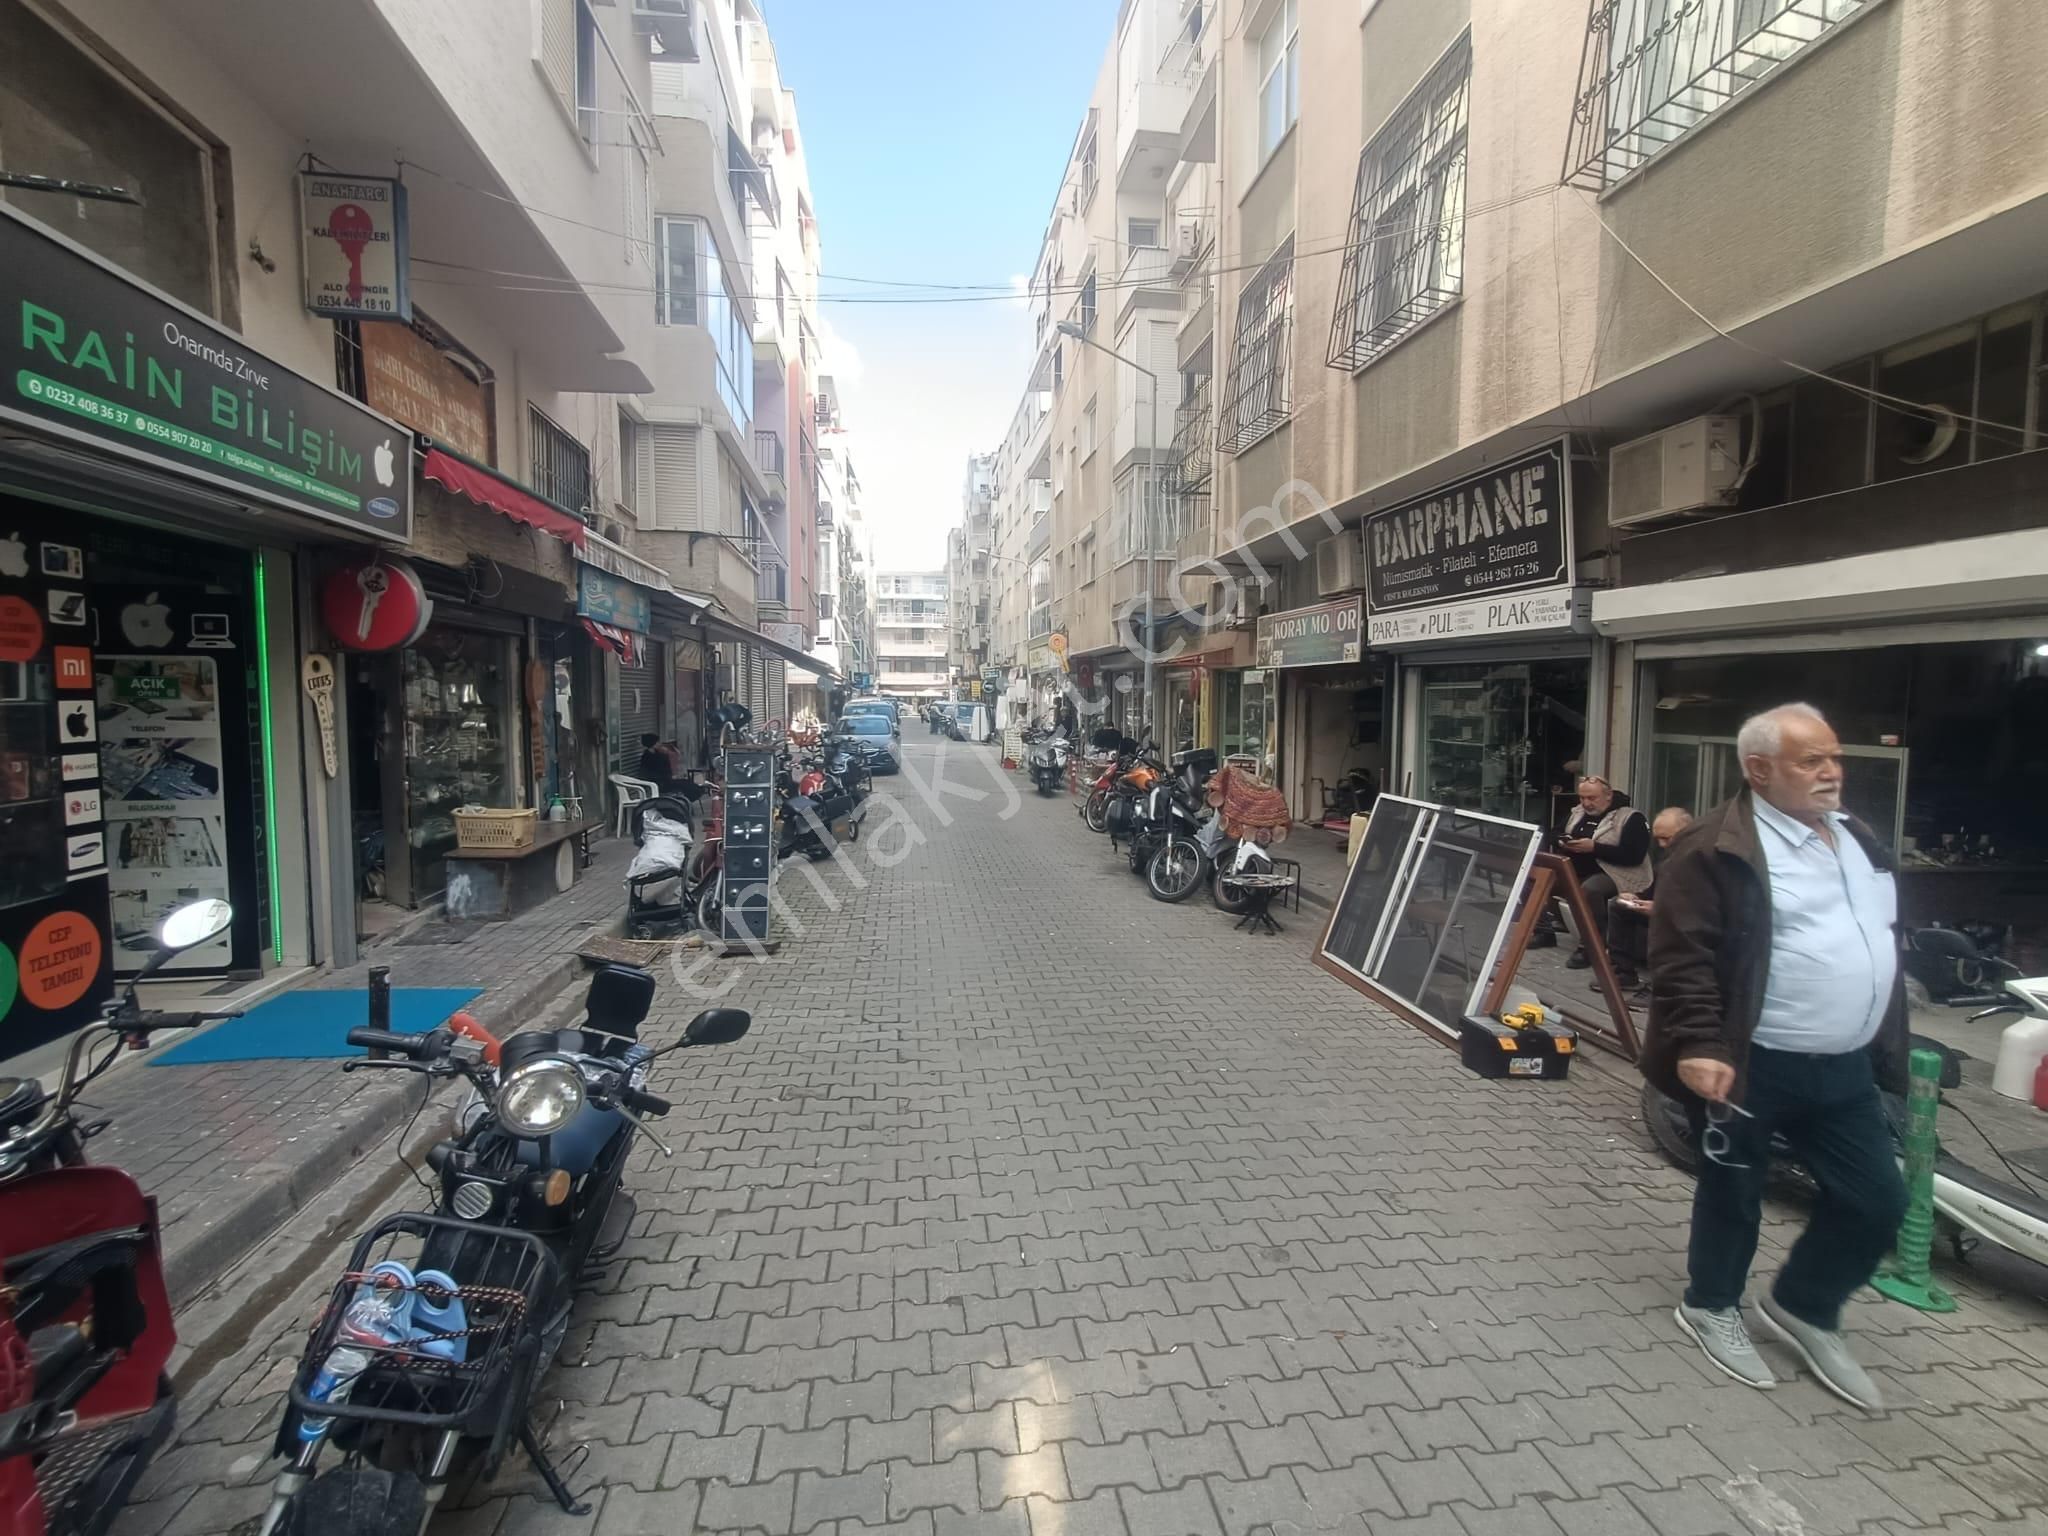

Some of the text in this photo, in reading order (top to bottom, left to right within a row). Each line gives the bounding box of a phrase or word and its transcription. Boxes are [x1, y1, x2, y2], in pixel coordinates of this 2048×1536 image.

[311, 182, 388, 202] ANAHTARCI
[317, 295, 342, 307] 0534
[379, 300, 391, 312] 10
[164, 322, 270, 391] Onarımda Zirve
[22, 300, 183, 409] RAİN
[211, 384, 362, 483] BİLİŞİM
[45, 386, 128, 425] 0232 408 36 37
[146, 421, 212, 454] 0554 907 20 20
[1374, 465, 1548, 568] DARPHANE
[1488, 540, 1538, 563] Efemera
[1473, 561, 1540, 585] 0544 263 75 26
[1274, 605, 1357, 641] KORAY MOOR
[1428, 612, 1454, 634] PUL
[1487, 600, 1532, 628] PLAK
[1372, 620, 1400, 641] PARA
[131, 725, 166, 733] TELEFON
[84, 801, 97, 811] LG
[48, 926, 72, 944] CEP
[29, 942, 92, 973] TELEFONU
